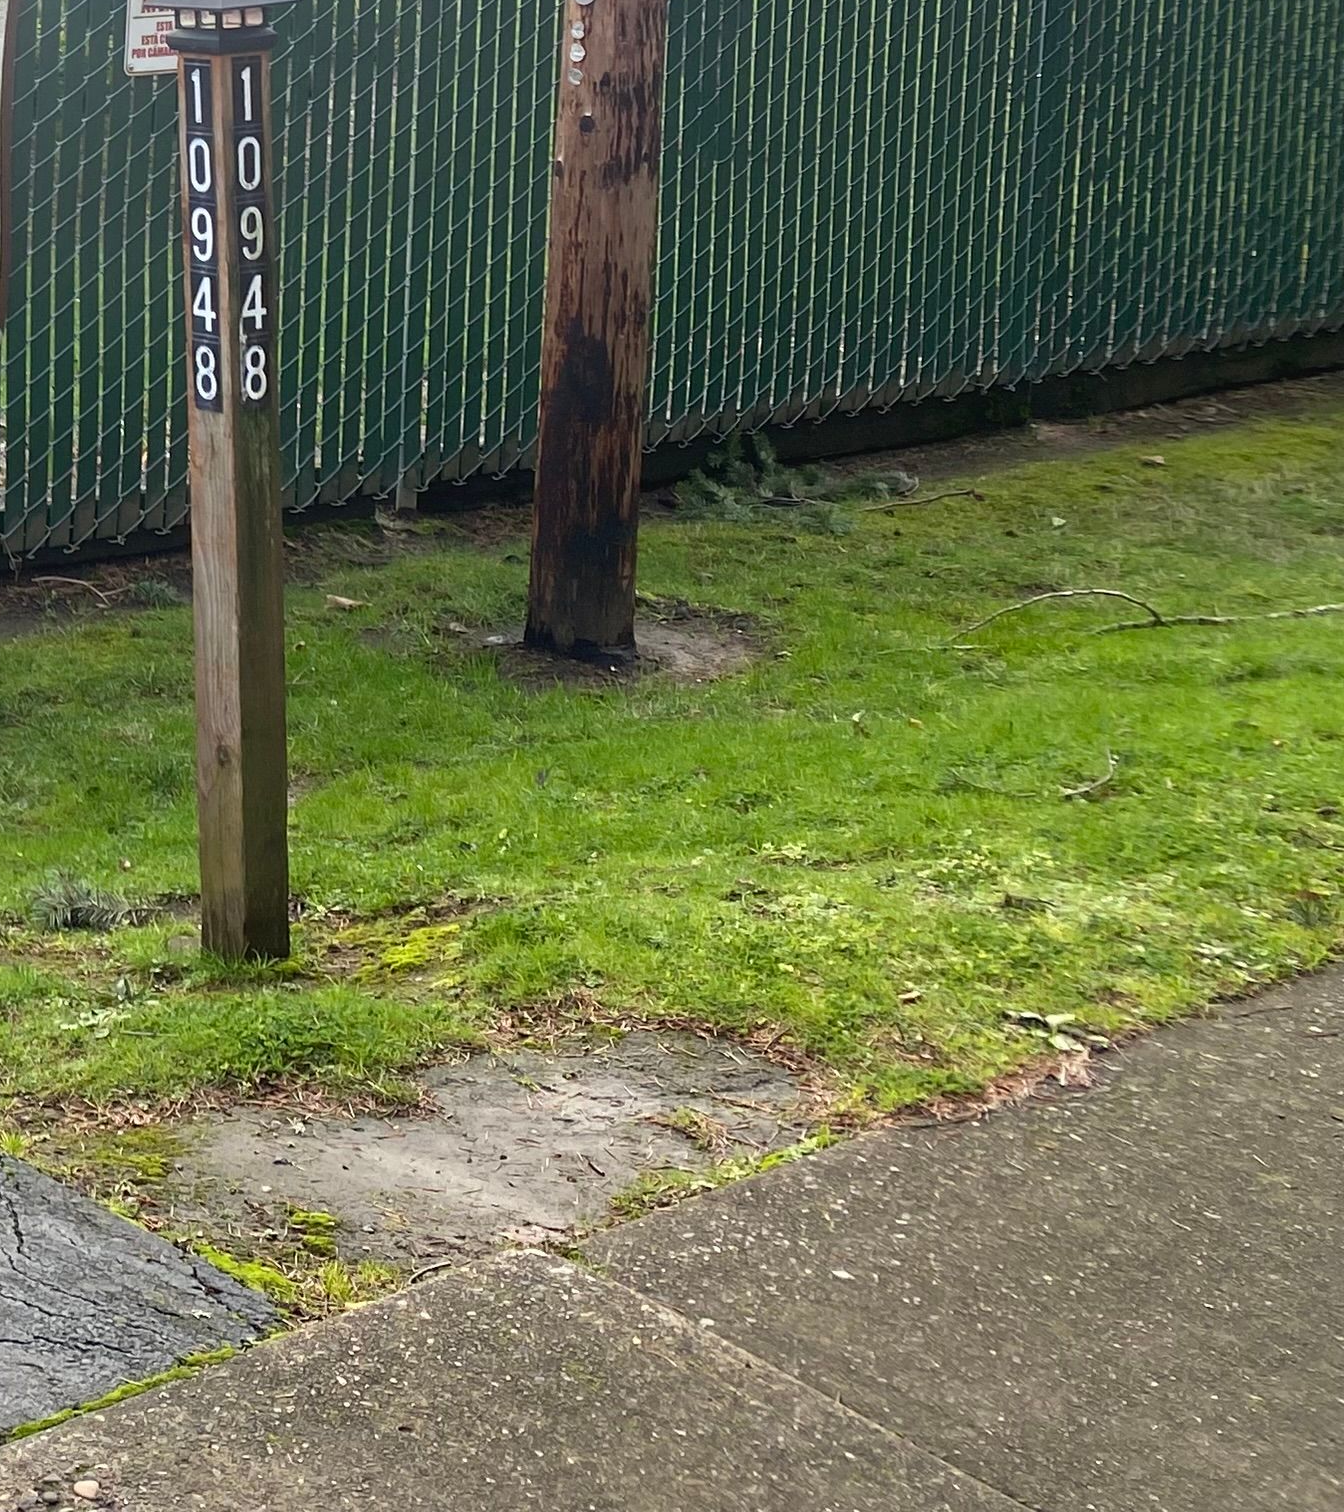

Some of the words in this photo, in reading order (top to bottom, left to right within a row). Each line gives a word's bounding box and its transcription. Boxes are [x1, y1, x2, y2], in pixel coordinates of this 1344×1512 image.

[132, 48, 146, 58] POR
[188, 67, 218, 401] 10948
[237, 66, 268, 401] 10948
